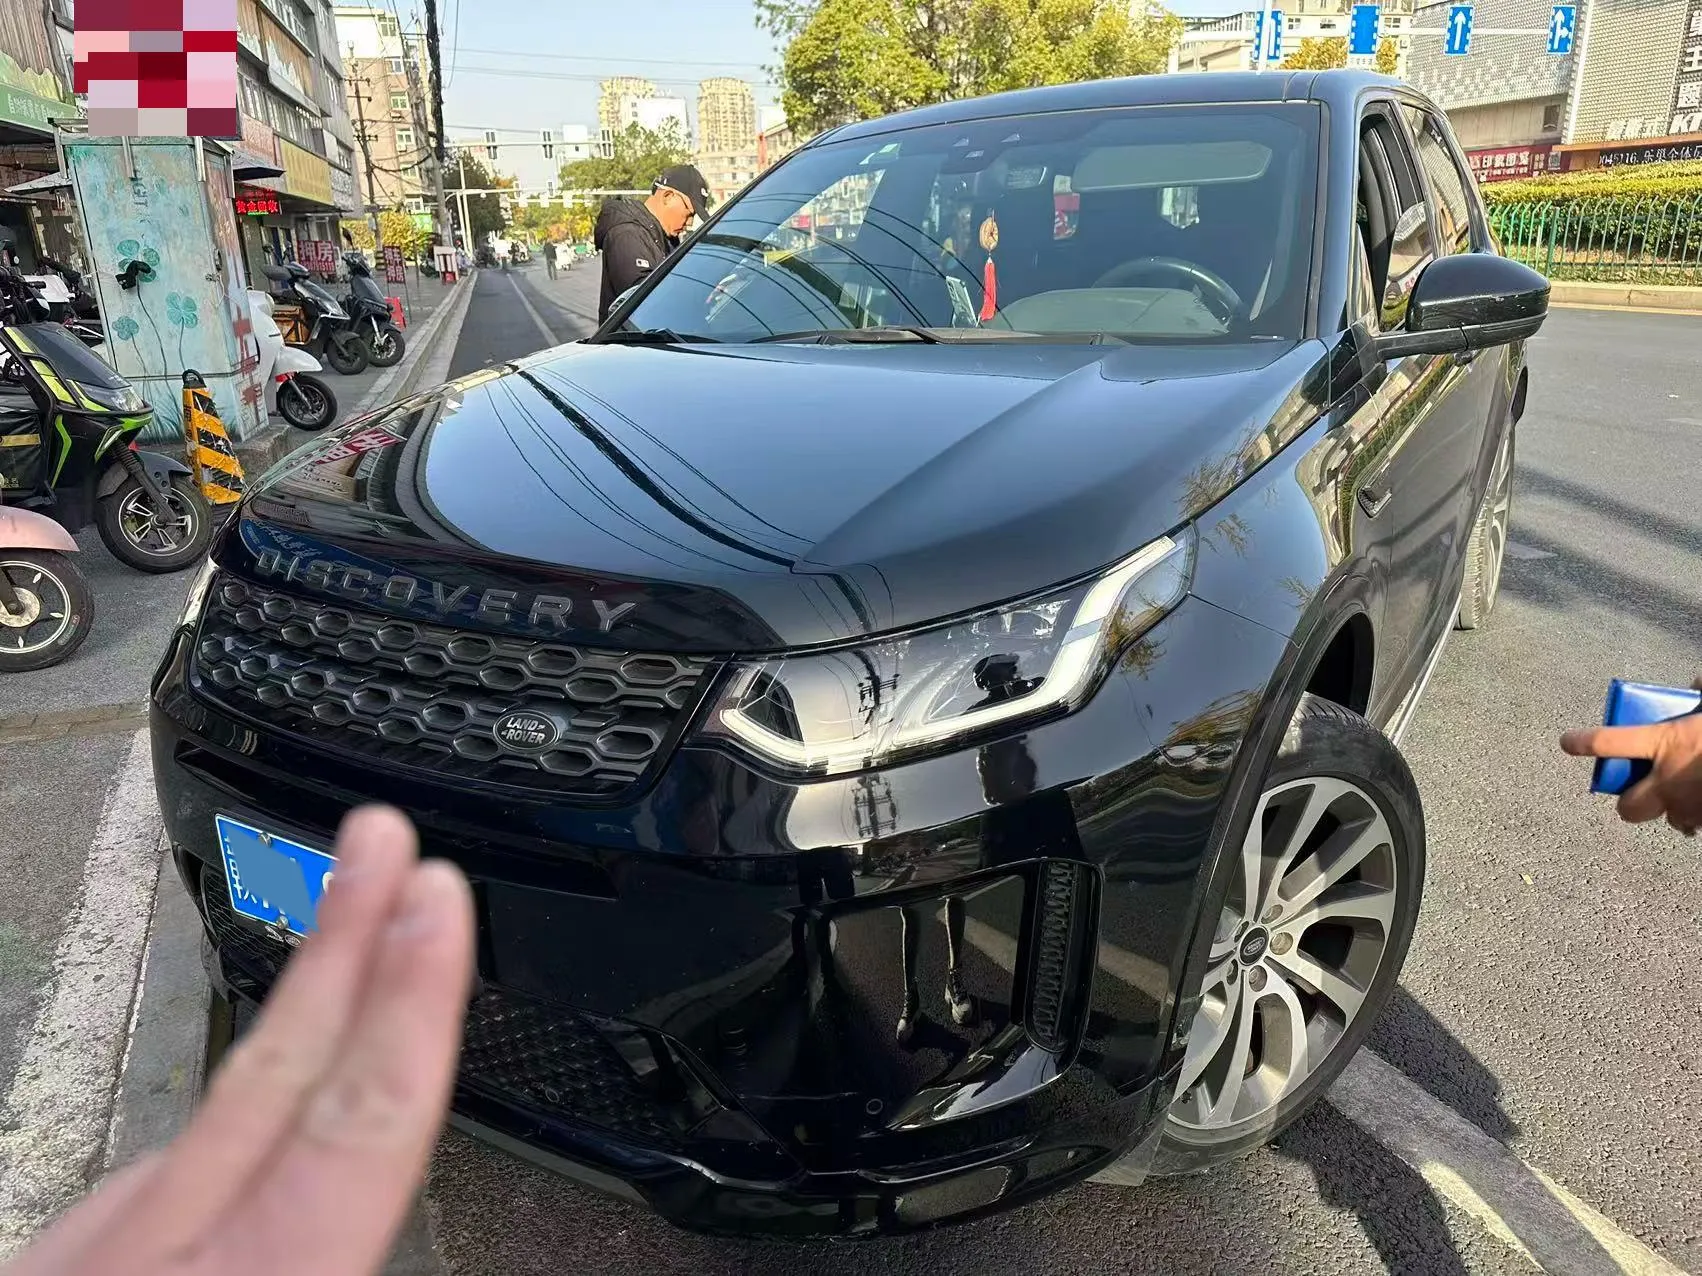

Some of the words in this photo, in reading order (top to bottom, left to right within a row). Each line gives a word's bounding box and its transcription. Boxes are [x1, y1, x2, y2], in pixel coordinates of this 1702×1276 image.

[298, 240, 333, 262] 押房
[257, 548, 637, 633] DISCOVERY
[506, 717, 539, 731] LAND
[505, 730, 546, 744] ROVER
